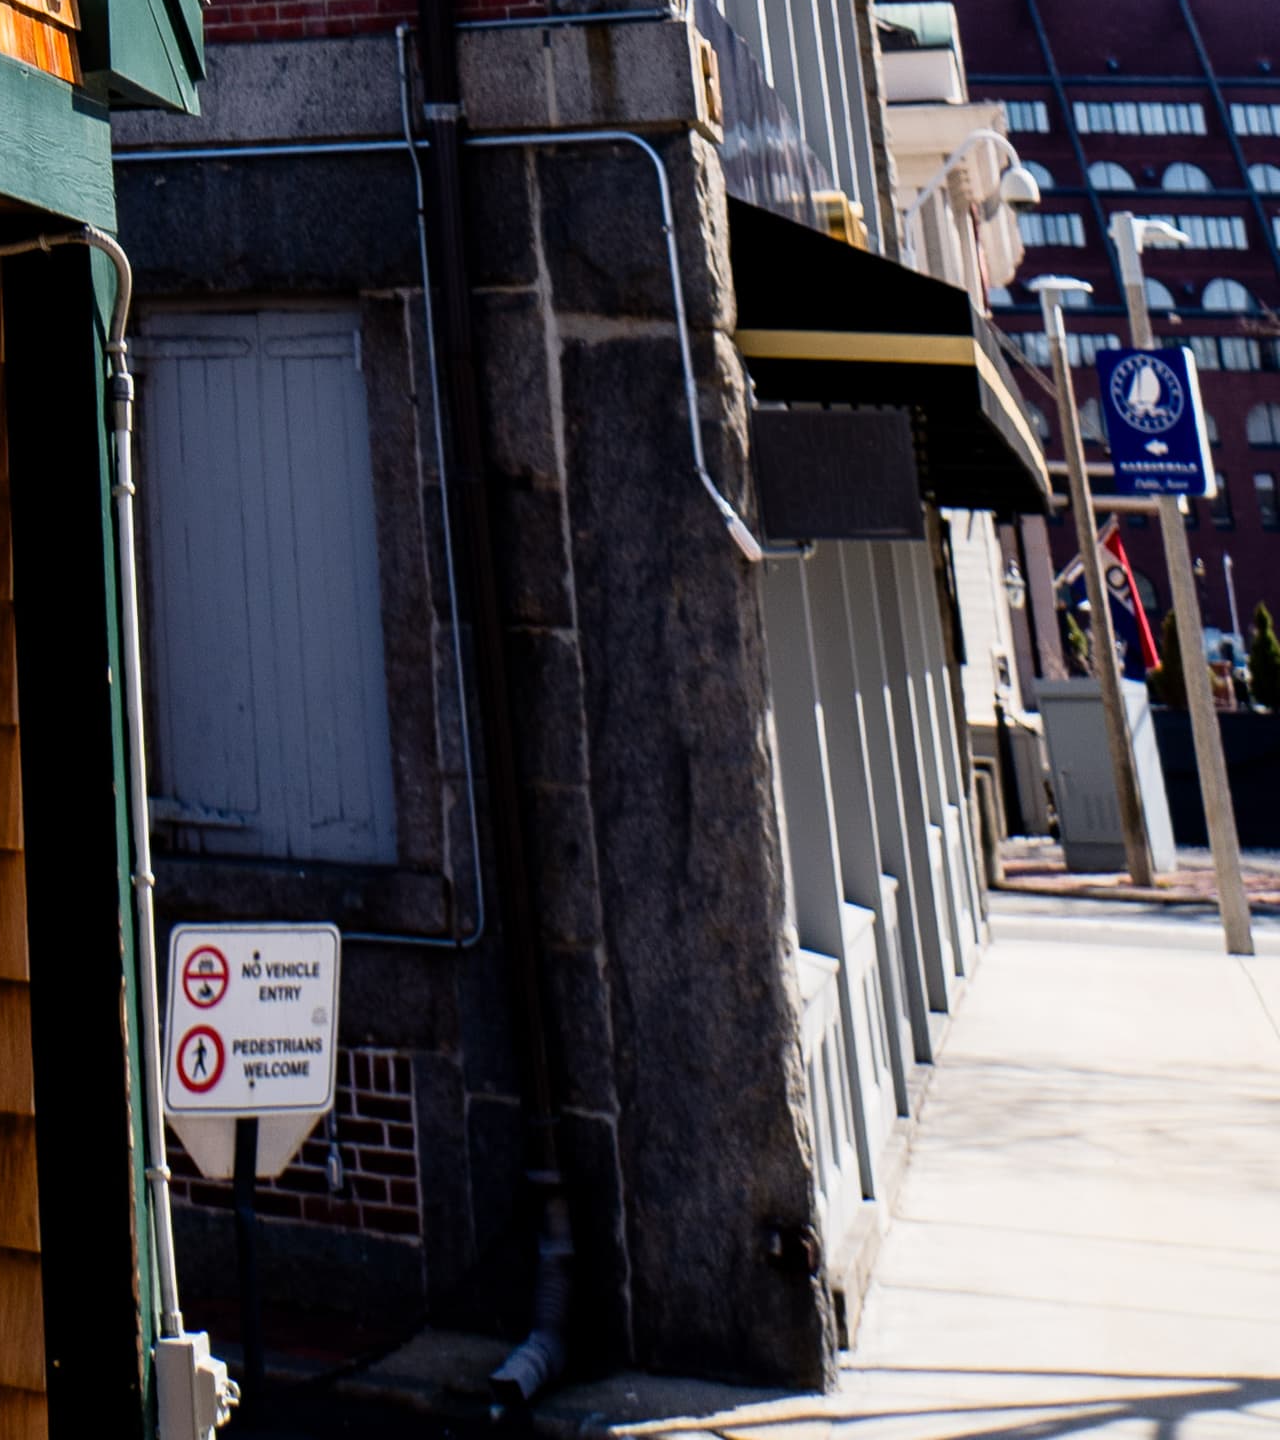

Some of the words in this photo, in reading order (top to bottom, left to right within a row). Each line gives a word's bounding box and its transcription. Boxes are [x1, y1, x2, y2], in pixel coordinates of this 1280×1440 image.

[242, 962, 261, 979] NO
[265, 961, 319, 979] VEHICLE
[259, 984, 301, 1001] ENTRY
[232, 1037, 322, 1056] PEDESTRIANS
[243, 1060, 309, 1079] WELCOME
